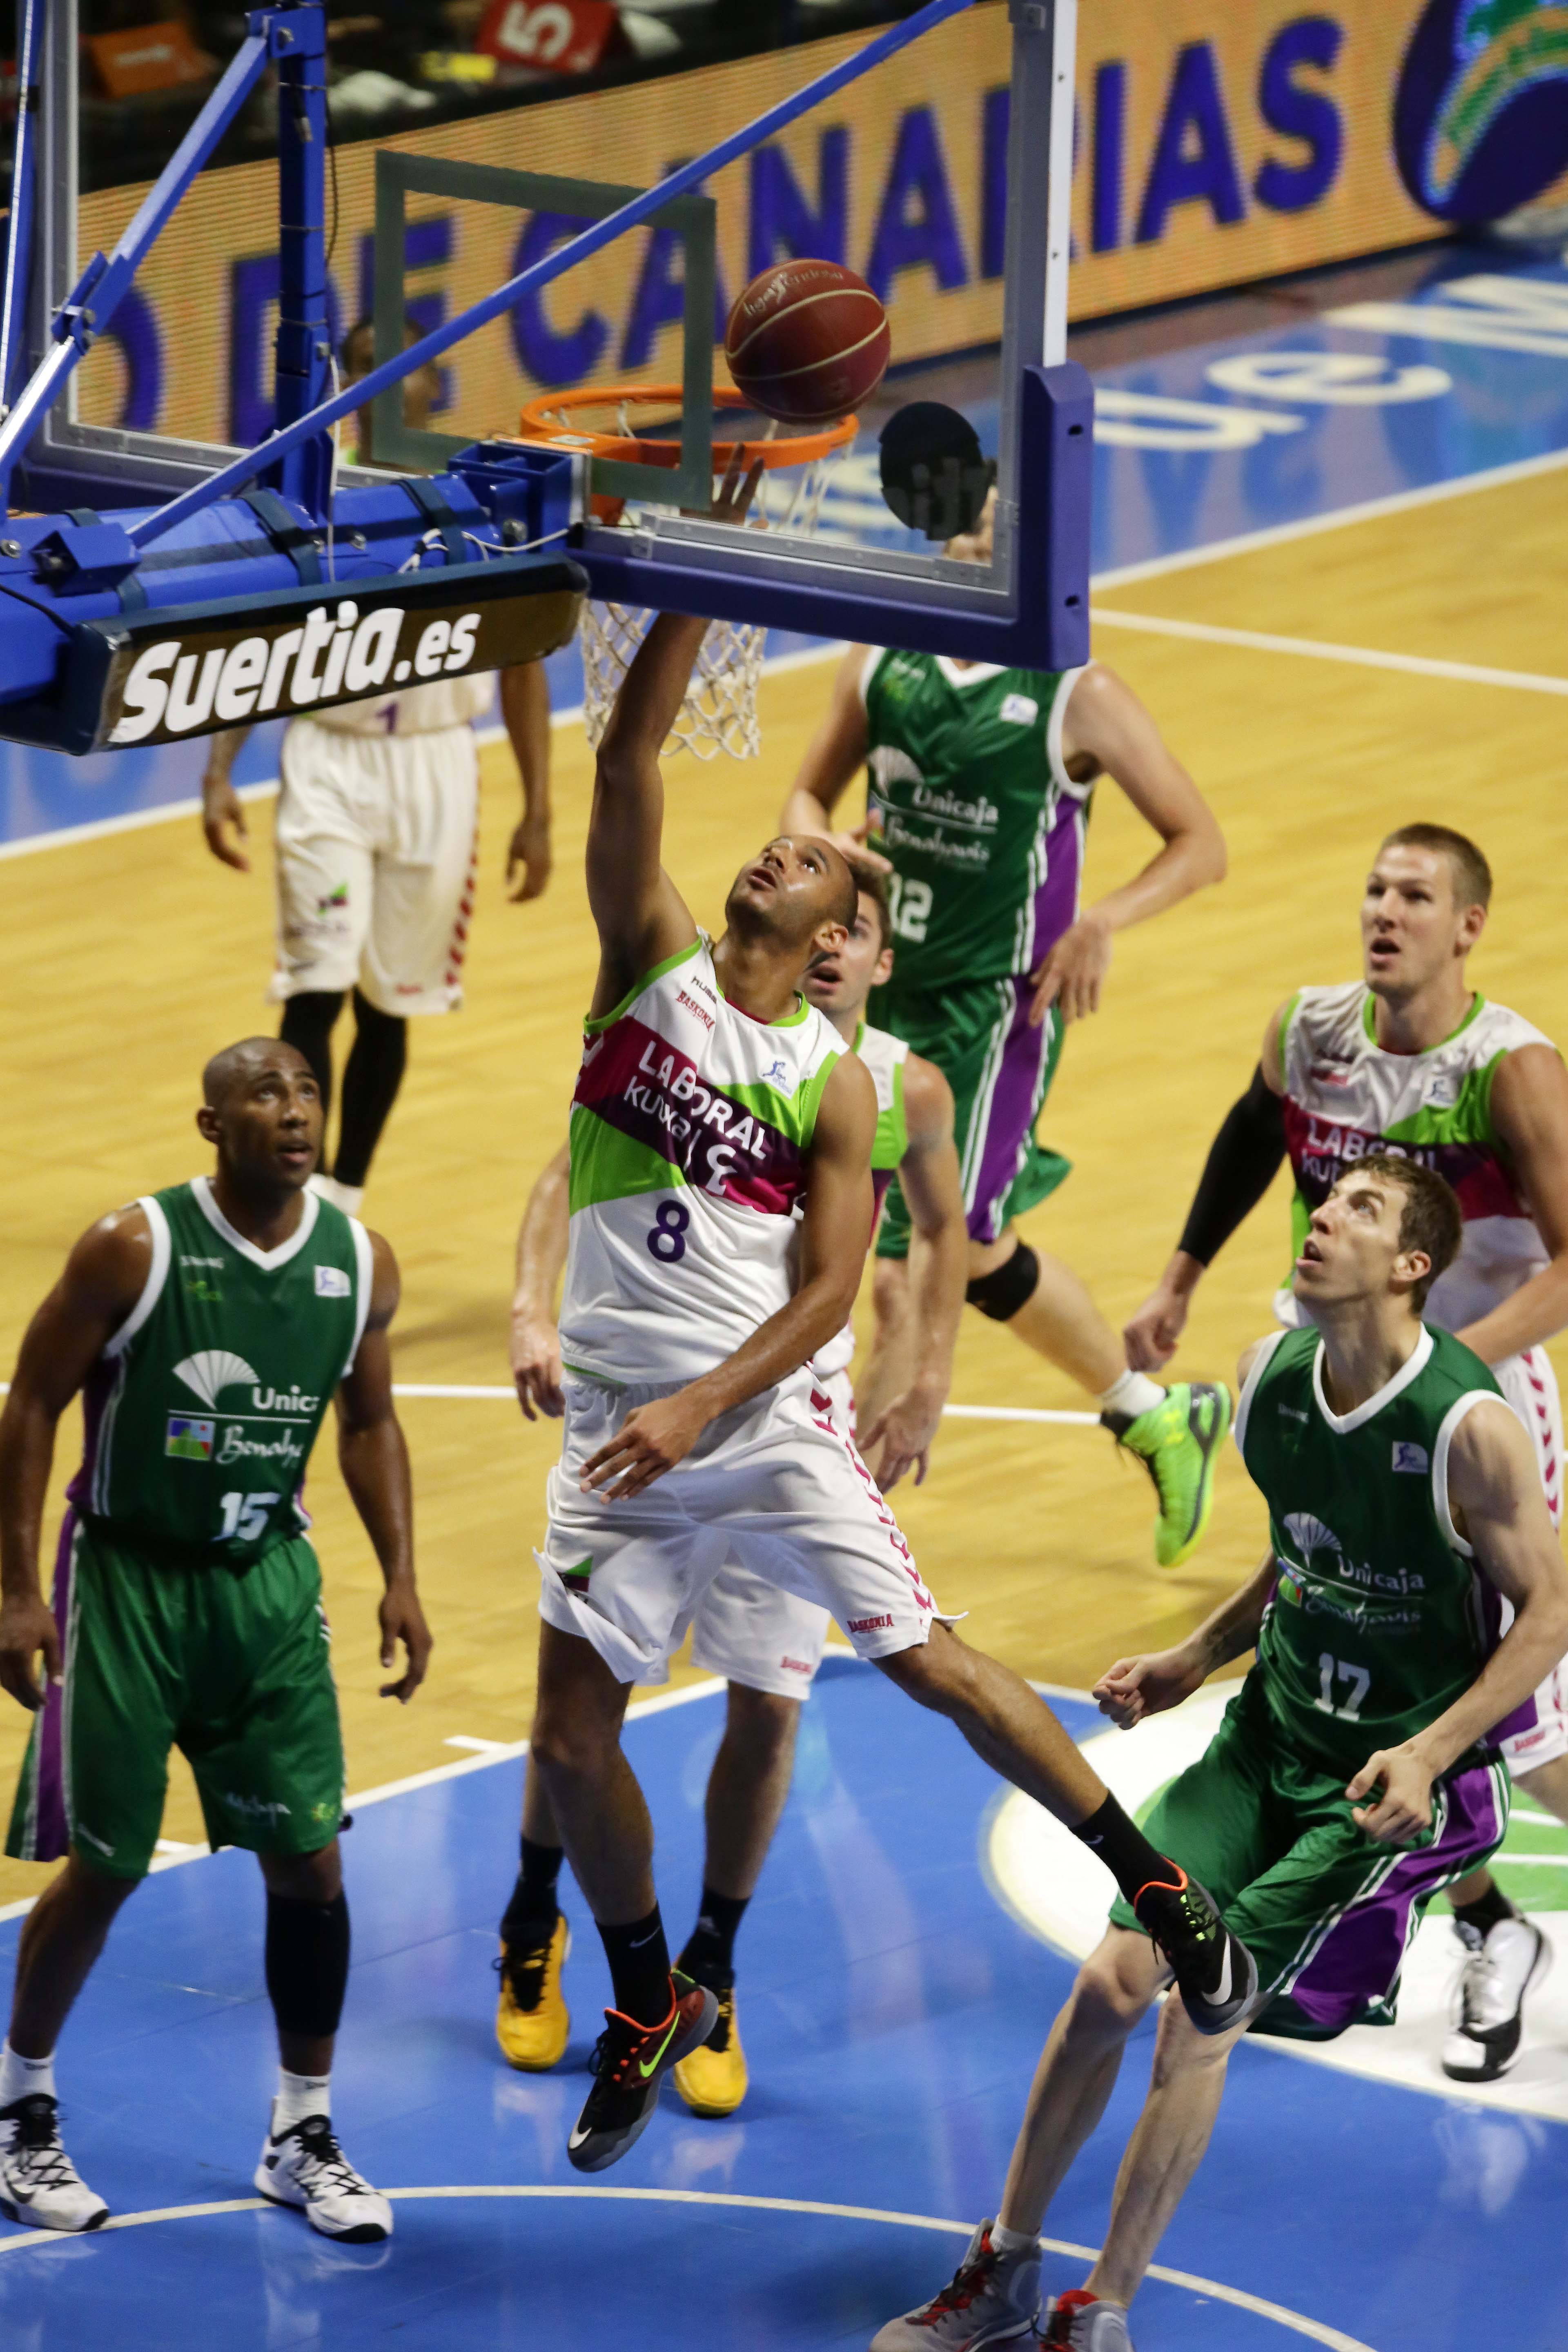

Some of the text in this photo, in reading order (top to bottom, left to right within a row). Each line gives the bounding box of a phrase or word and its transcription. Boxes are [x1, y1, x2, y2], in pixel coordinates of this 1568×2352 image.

[107, 600, 482, 743] Suertia.es
[912, 784, 999, 825] Unicaja
[639, 1040, 767, 1160] LABORAL
[646, 1200, 690, 1263] 8
[212, 1491, 282, 1541] 15
[1337, 1554, 1425, 1594] Unicaja
[1314, 1652, 1371, 1722] 17
